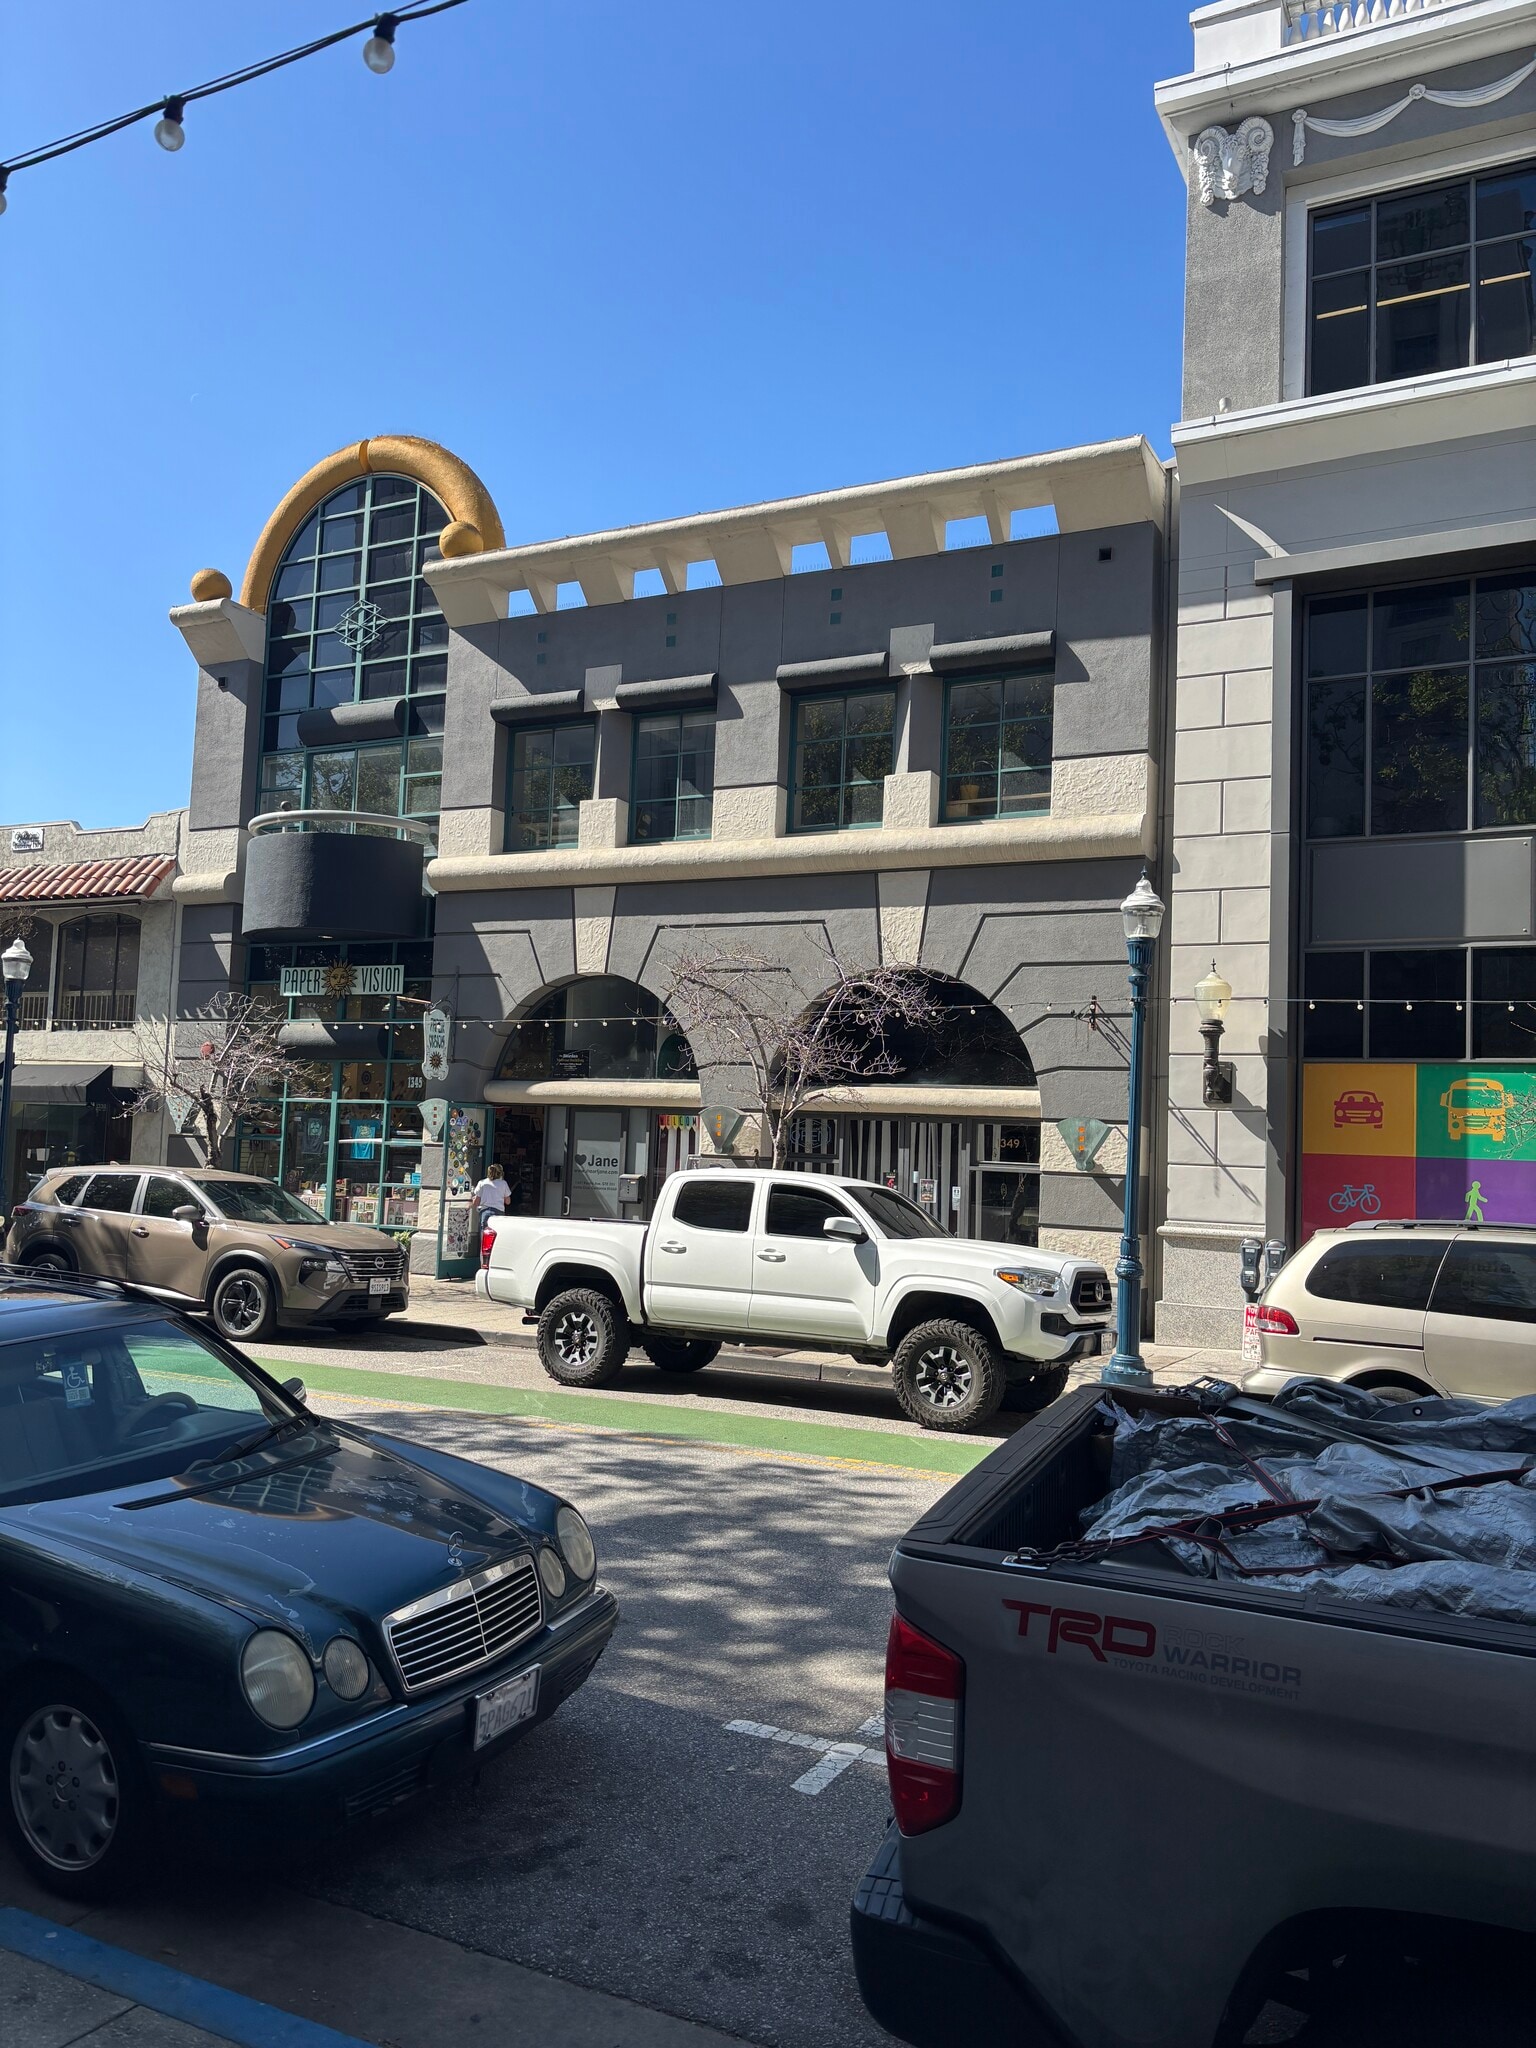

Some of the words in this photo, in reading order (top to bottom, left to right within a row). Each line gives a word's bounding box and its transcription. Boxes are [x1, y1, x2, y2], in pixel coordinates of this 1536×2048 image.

[283, 968, 321, 994] PAPER
[361, 966, 400, 993] VISION
[407, 1076, 423, 1089] 1345
[659, 1116, 698, 1127] WELCOM
[587, 1154, 619, 1168] Jane
[1002, 1599, 1157, 1663] TRD
[1162, 1624, 1247, 1656] ROCK
[1113, 1656, 1160, 1675] TOYOTA
[1161, 1666, 1207, 1684] RACING
[1210, 1675, 1301, 1701] DEVELOPMENT
[1163, 1645, 1301, 1687] WARRIOR
[479, 1686, 533, 1739] 5PAG671
